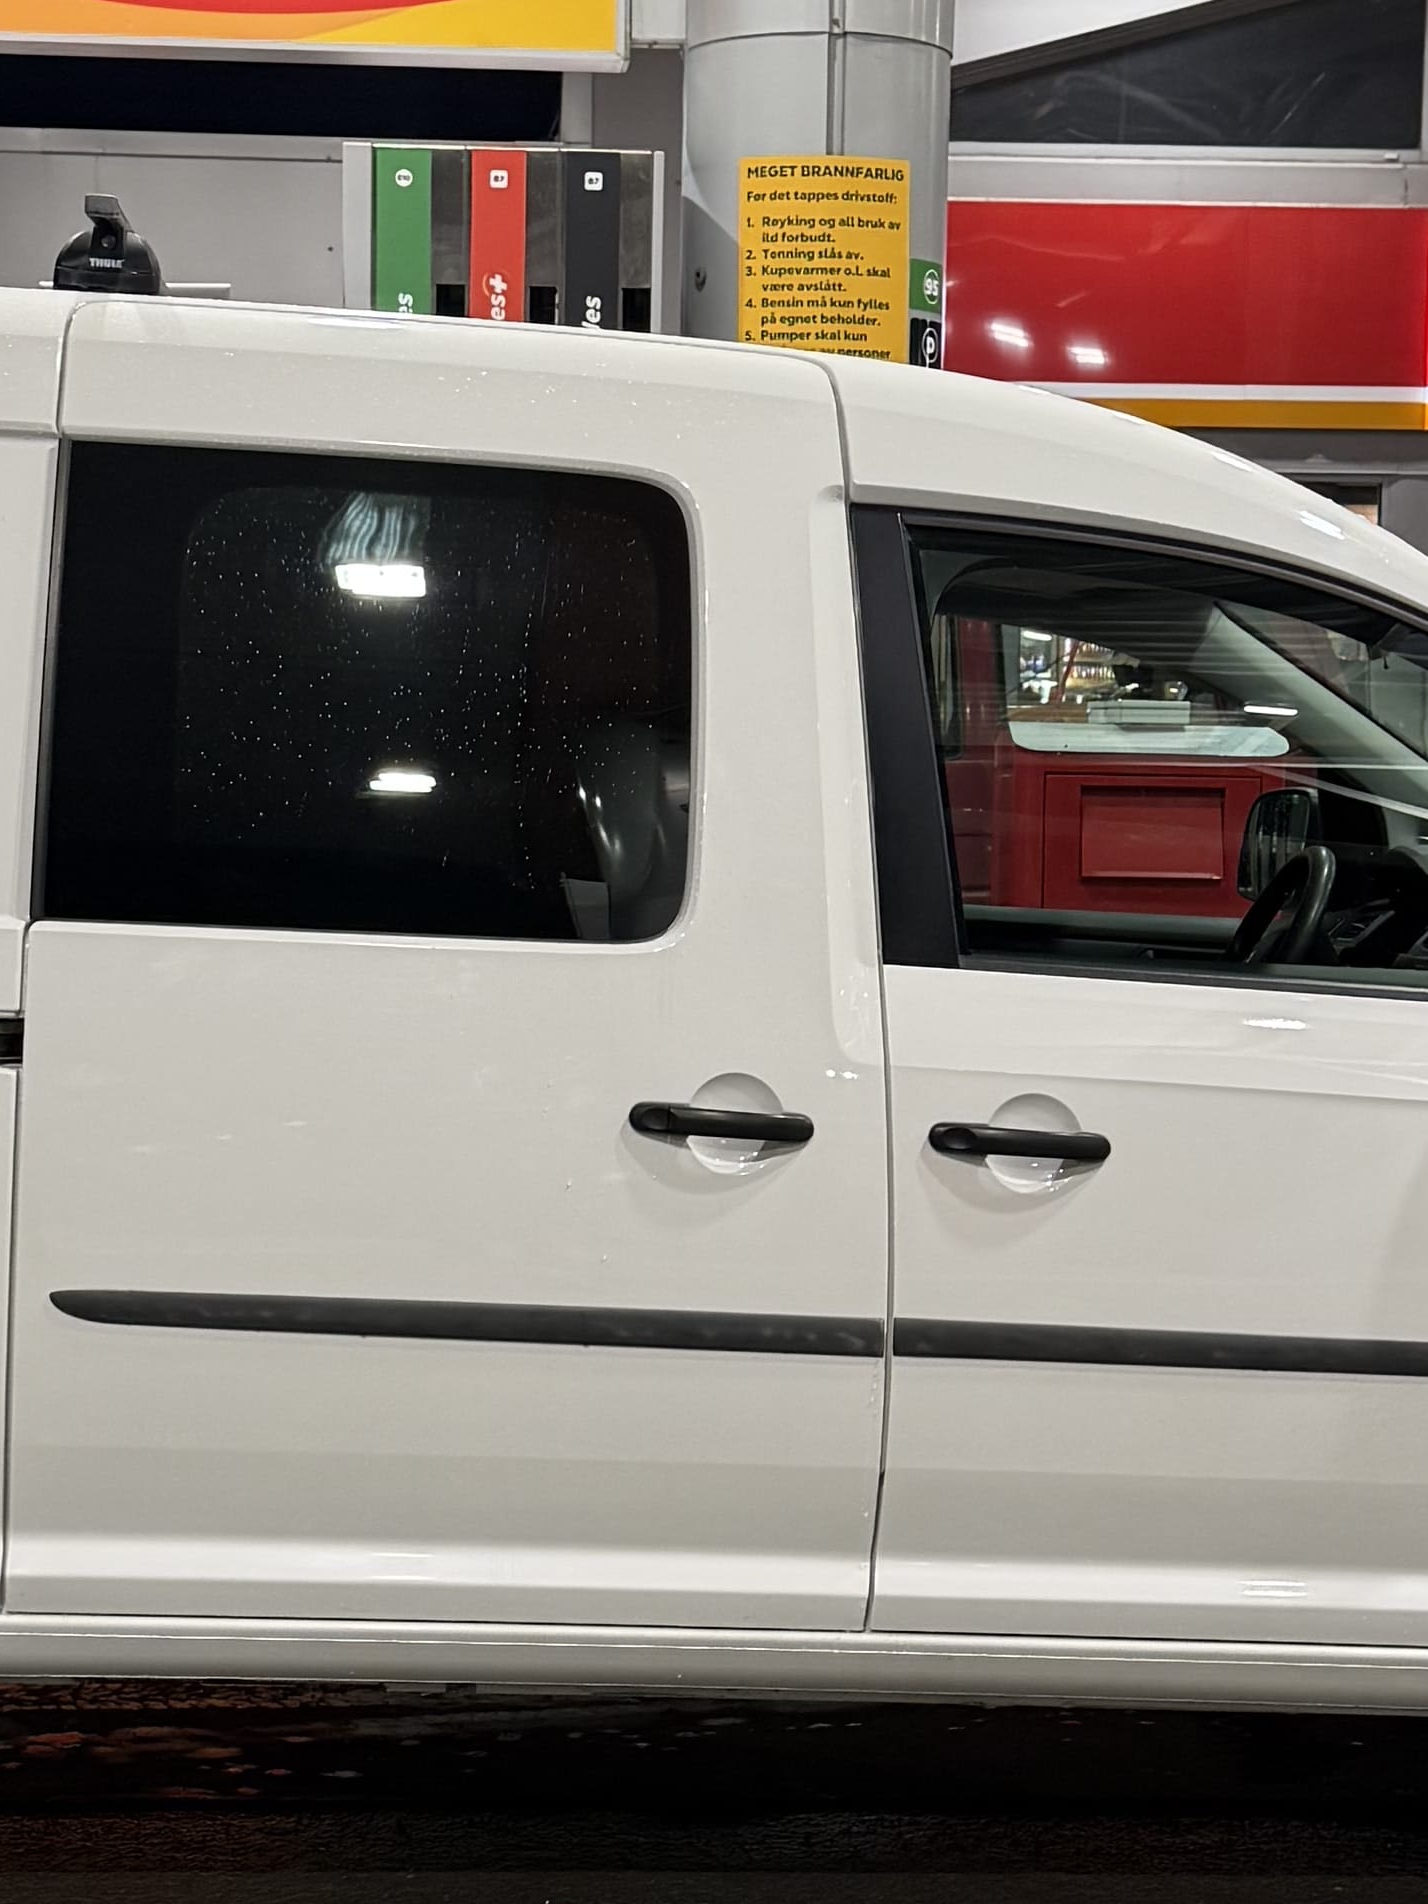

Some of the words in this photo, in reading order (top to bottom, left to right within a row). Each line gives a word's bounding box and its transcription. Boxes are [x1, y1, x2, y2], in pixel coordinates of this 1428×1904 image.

[747, 165, 798, 179] MEGET
[801, 164, 905, 182] BRANNFARLIG
[769, 190, 791, 201] det
[794, 190, 839, 204] tappes
[841, 189, 898, 205] drivstoff:
[746, 217, 754, 228] 1.
[761, 216, 815, 229] Røyking
[818, 219, 836, 229] og
[838, 216, 855, 227] all
[857, 217, 885, 229] bruk
[887, 221, 901, 231] av
[761, 232, 779, 243] ild
[781, 232, 836, 243] forbudt.
[745, 250, 756, 260] 2.
[817, 248, 842, 260] slås
[845, 252, 864, 261] av.
[745, 266, 756, 277] 3.
[865, 267, 891, 279] skal
[761, 282, 794, 292] være
[797, 281, 847, 293] avslått.
[924, 278, 940, 296] 95
[745, 298, 757, 309] 4.
[761, 297, 804, 309] Bensin
[806, 296, 827, 309] må
[829, 297, 854, 309] kun
[856, 298, 890, 312] fylles
[761, 313, 776, 327] på
[779, 315, 817, 327] egnet
[819, 315, 881, 327] beholder.
[745, 331, 756, 342] 5.
[760, 330, 812, 342] Pumper
[814, 330, 841, 341] skal
[844, 331, 868, 342] kun
[837, 348, 891, 359] personer
